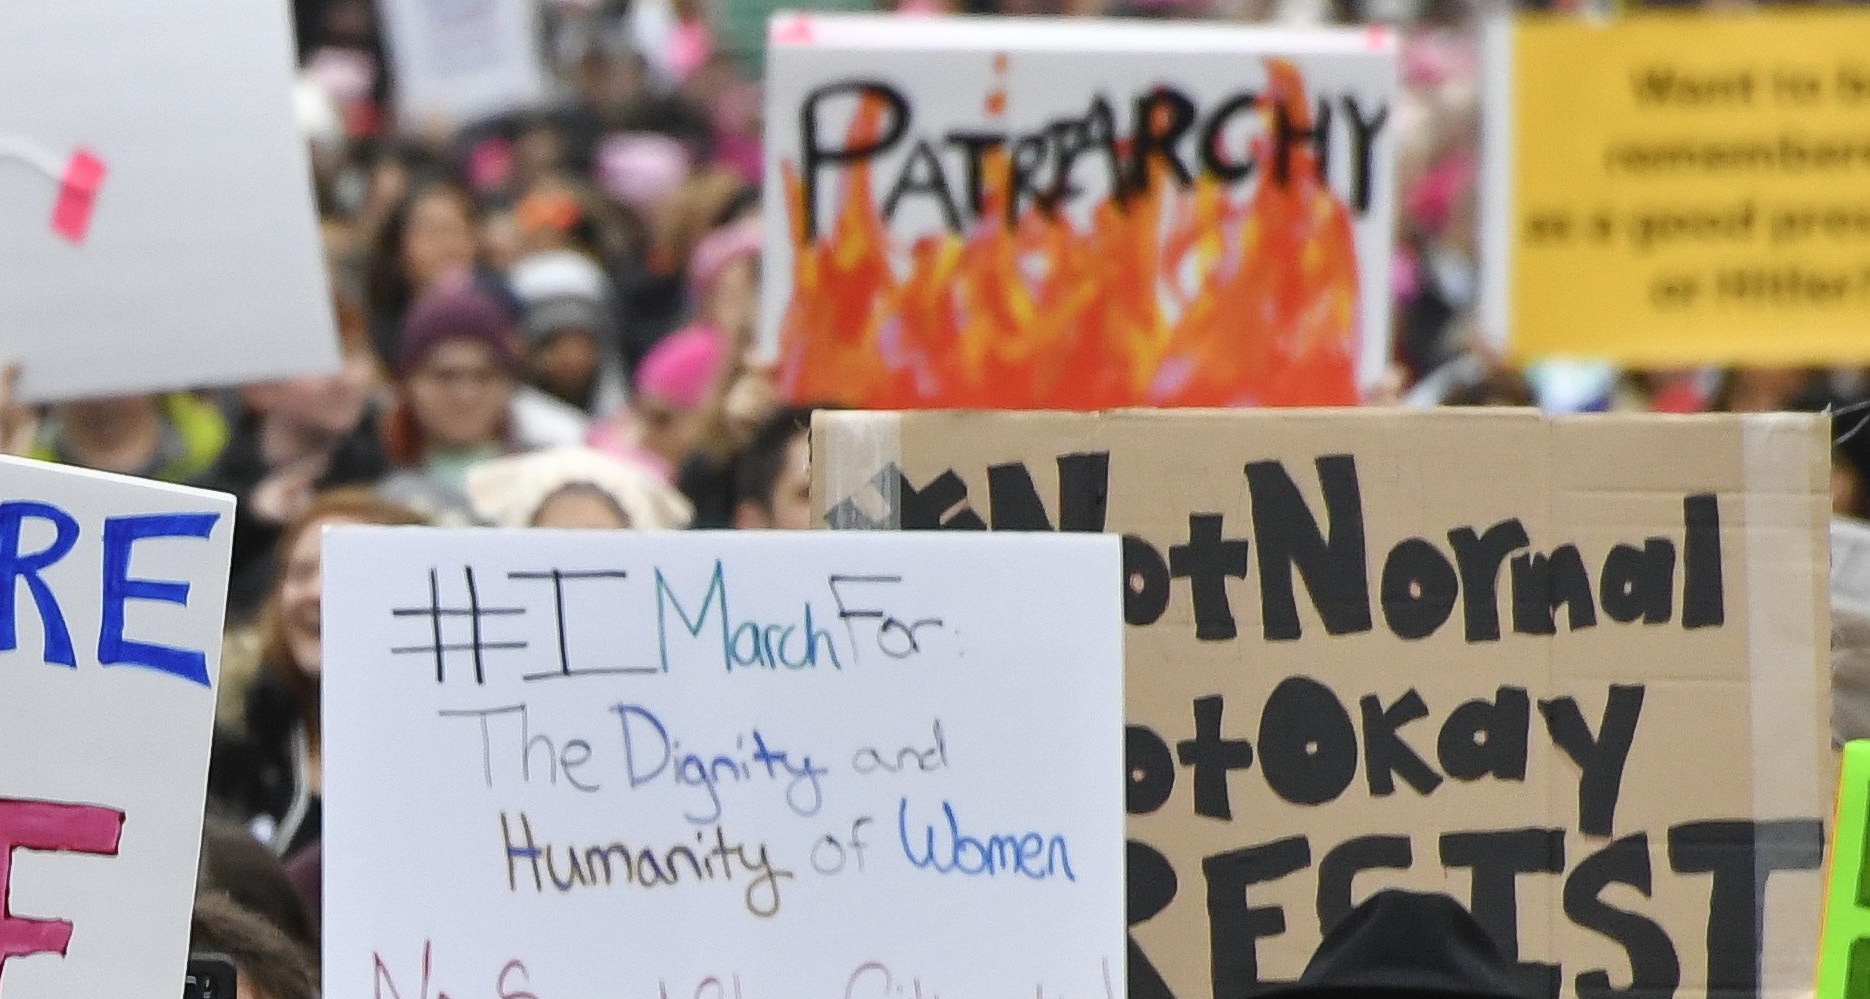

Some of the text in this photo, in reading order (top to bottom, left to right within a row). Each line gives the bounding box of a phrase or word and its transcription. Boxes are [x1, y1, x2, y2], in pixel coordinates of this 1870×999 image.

[438, 702, 949, 824] The Dignity and
[1126, 675, 1646, 838] otOkay
[499, 798, 1079, 917] Humanity of Women
